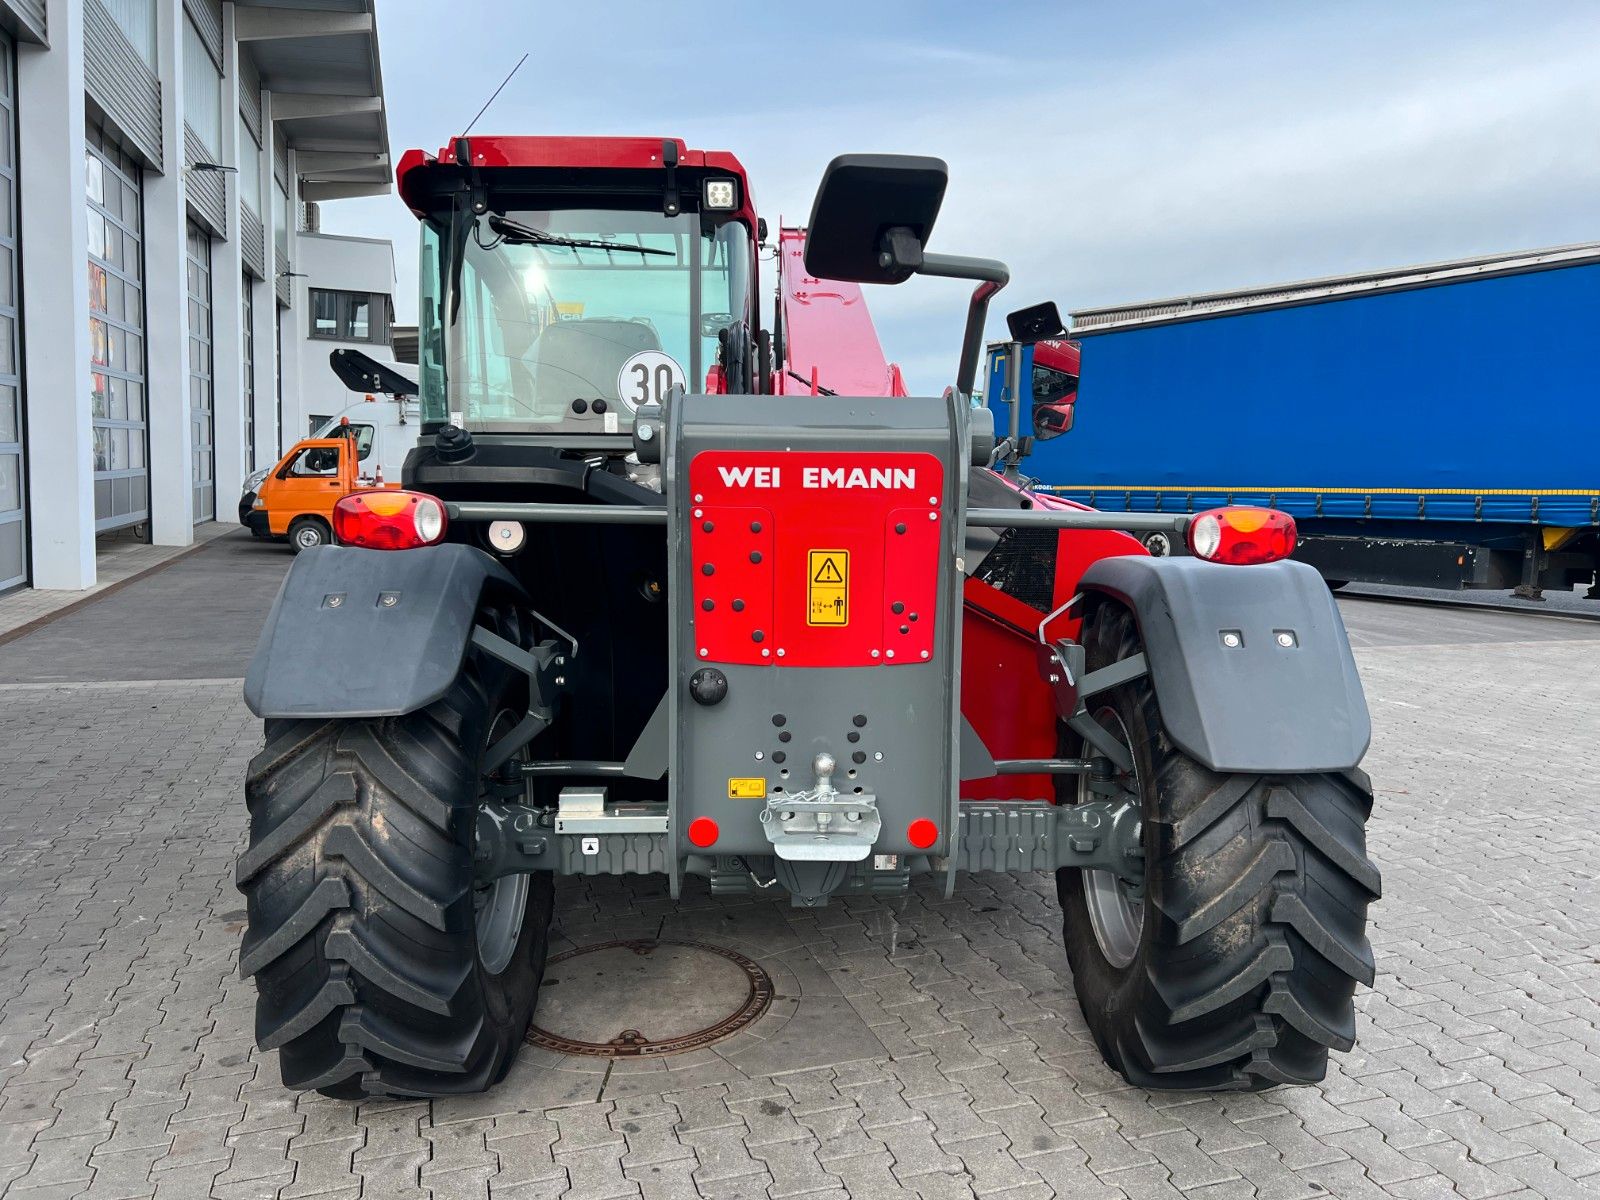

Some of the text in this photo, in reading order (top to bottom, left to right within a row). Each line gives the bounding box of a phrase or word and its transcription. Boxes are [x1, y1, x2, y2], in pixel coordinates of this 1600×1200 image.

[631, 363, 673, 405] 30
[717, 467, 915, 489] WEI EMANN
